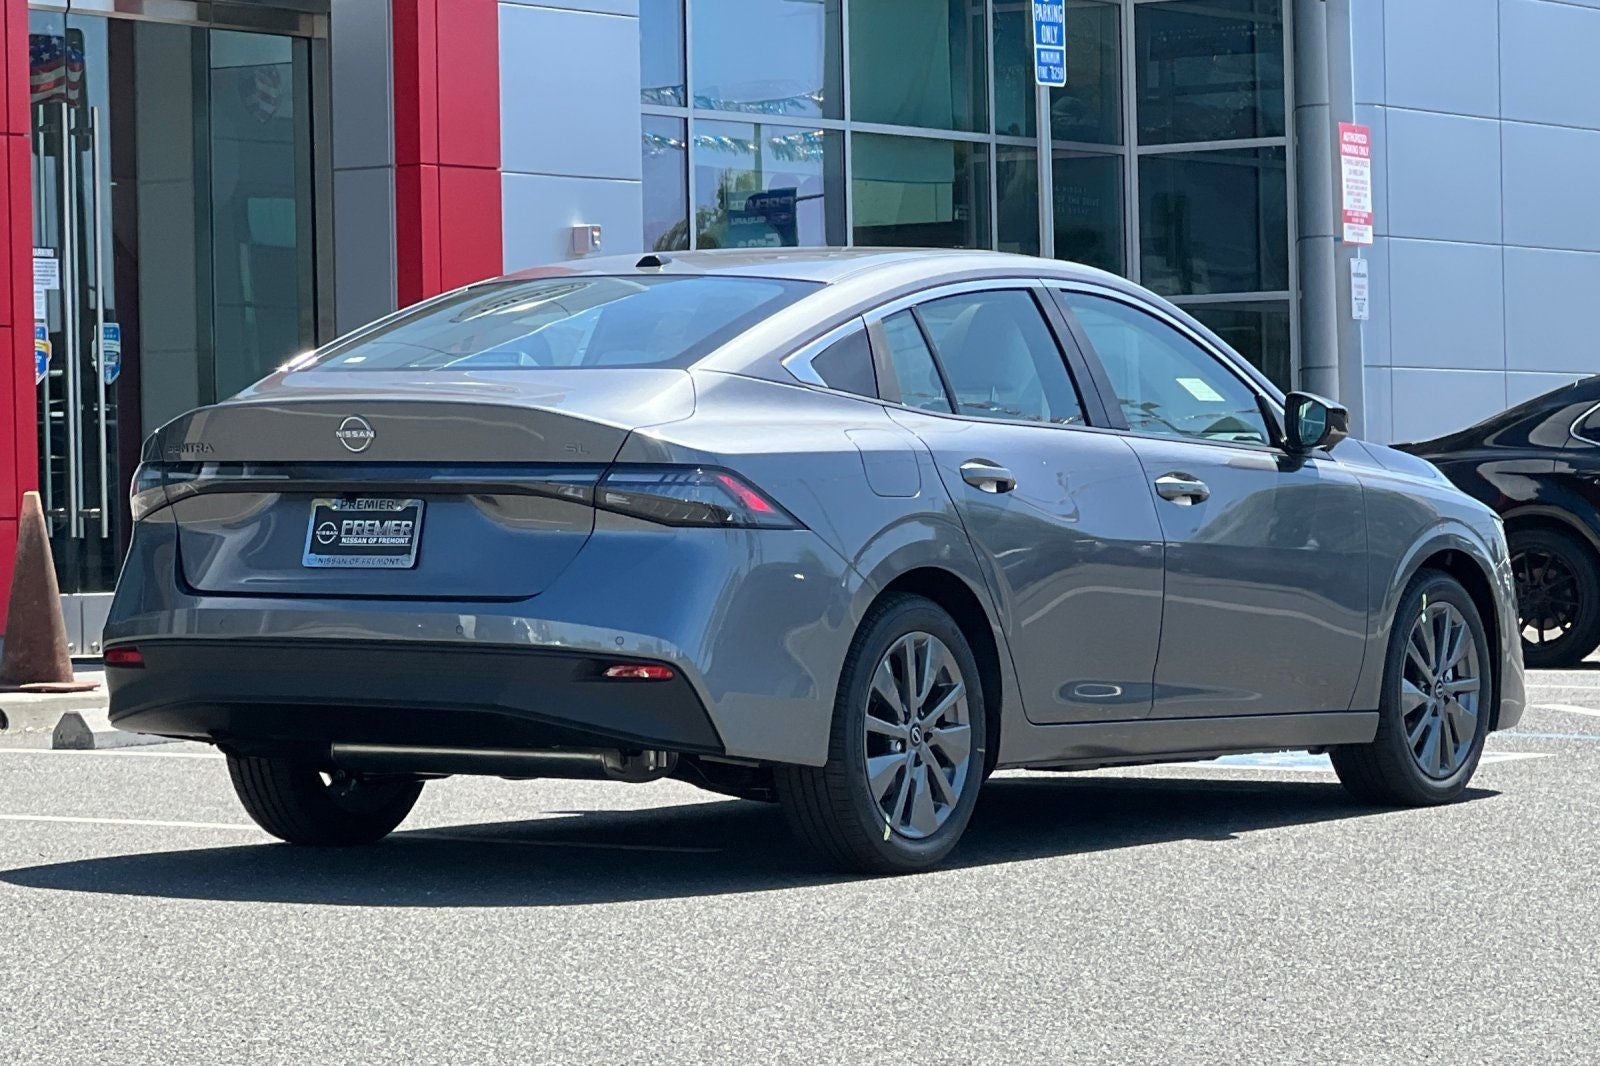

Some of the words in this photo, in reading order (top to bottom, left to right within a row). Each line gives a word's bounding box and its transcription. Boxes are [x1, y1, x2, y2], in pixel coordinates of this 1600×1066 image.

[1034, 3, 1063, 23] PARKING
[1041, 24, 1058, 44] ONLY
[335, 430, 375, 438] NISSAN
[564, 443, 591, 455] SL
[340, 500, 395, 511] PREMIER
[340, 520, 413, 536] PREMIER
[317, 557, 347, 566] NISSAN
[349, 557, 360, 566] OF
[361, 557, 400, 566] FREMONT
